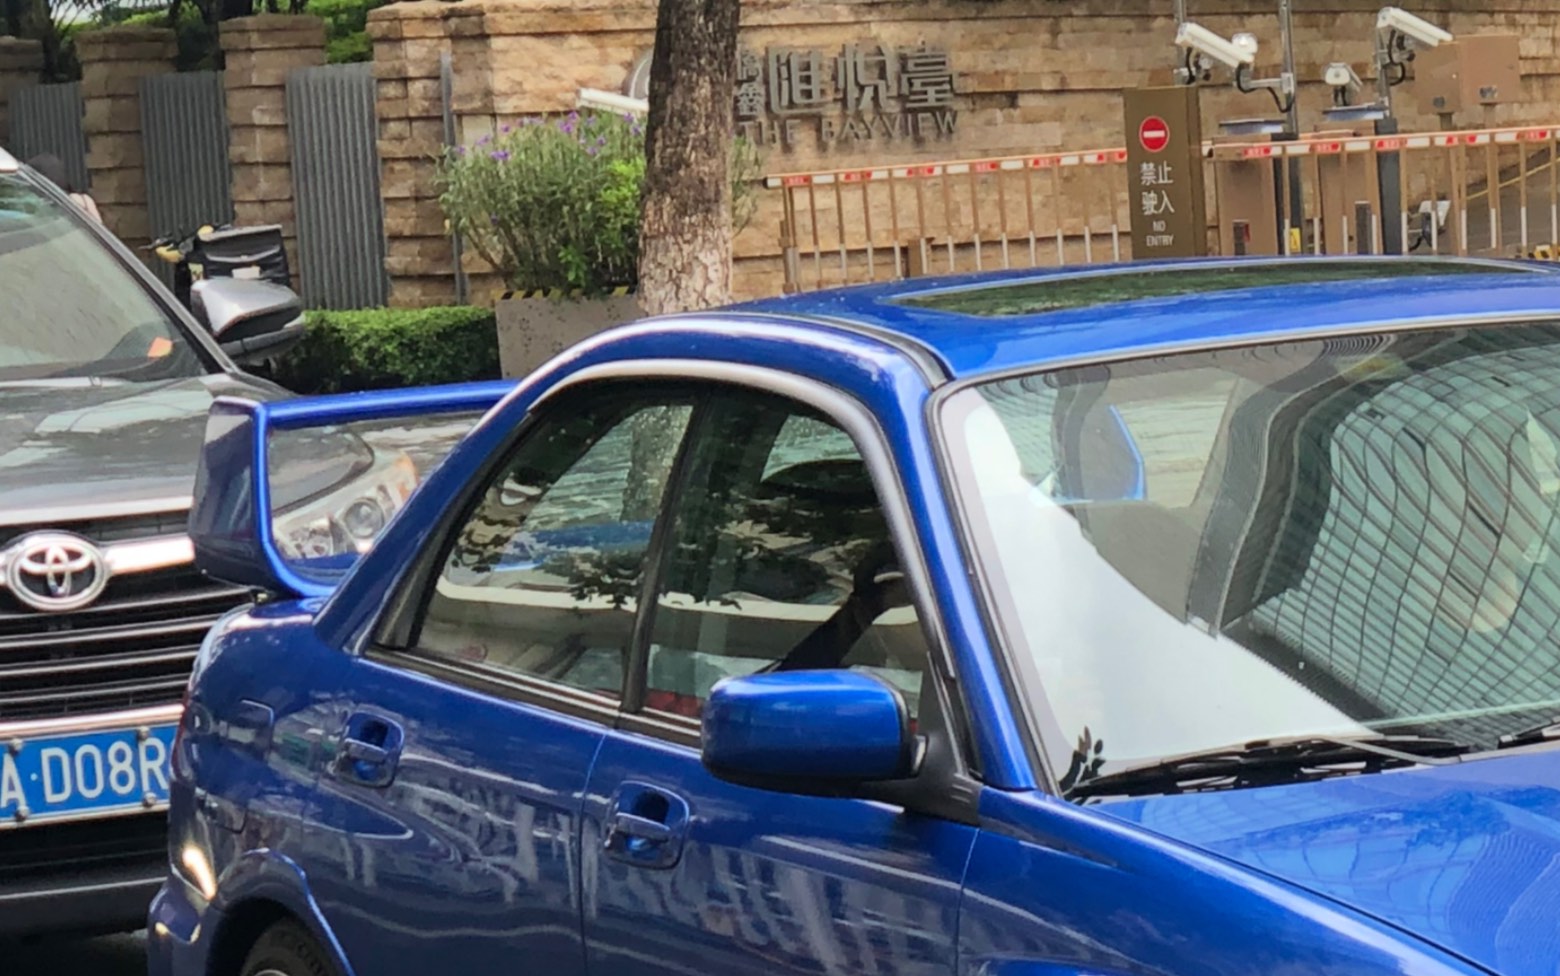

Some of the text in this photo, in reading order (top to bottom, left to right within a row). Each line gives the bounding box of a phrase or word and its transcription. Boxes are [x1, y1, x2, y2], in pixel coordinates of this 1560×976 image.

[739, 110, 957, 147] THE BAYVIEW
[1140, 160, 1174, 186] 禁止
[1141, 190, 1175, 215] 驶入
[1153, 221, 1166, 232] NO
[1146, 234, 1174, 247] ENTRY
[0, 737, 175, 808] A·D08R
